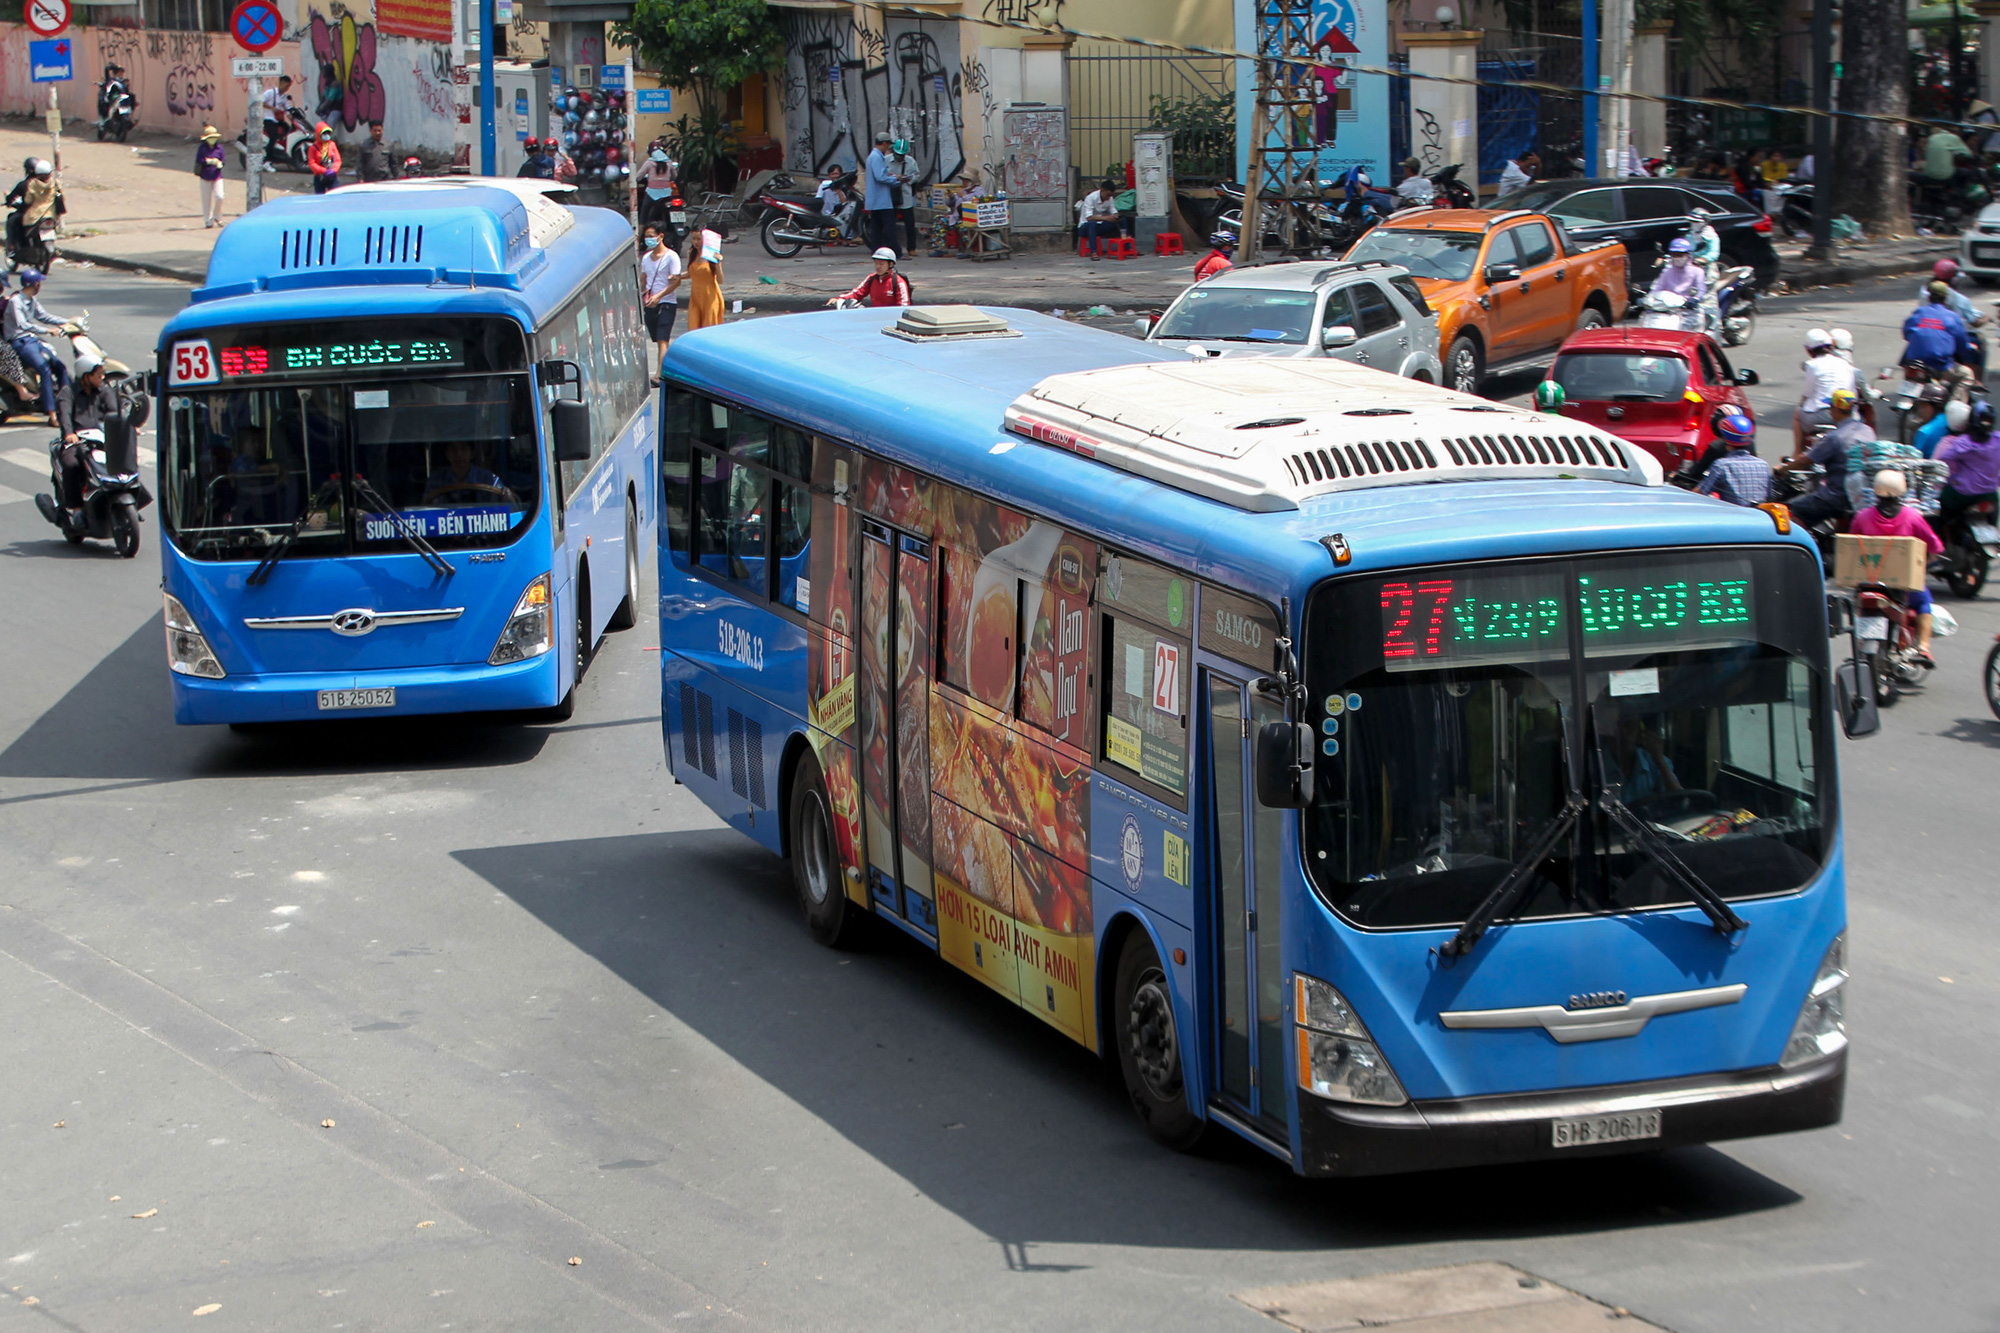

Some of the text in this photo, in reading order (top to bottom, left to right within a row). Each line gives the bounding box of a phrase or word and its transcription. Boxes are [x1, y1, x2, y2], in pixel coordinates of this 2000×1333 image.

[176, 345, 210, 381] 53
[437, 513, 465, 536] BẾN
[466, 510, 508, 534] THÀNH
[1058, 599, 1083, 657] Nam
[1215, 609, 1262, 649] SAMCO
[1380, 580, 1454, 657] 27
[718, 618, 764, 673] 51B-206.13
[321, 690, 393, 707] 51B-250.52
[1156, 645, 1178, 711] 27
[937, 883, 1078, 992] HƠN 15 LOẠI AXIT AMIN
[1569, 990, 1626, 1008] SAMCO
